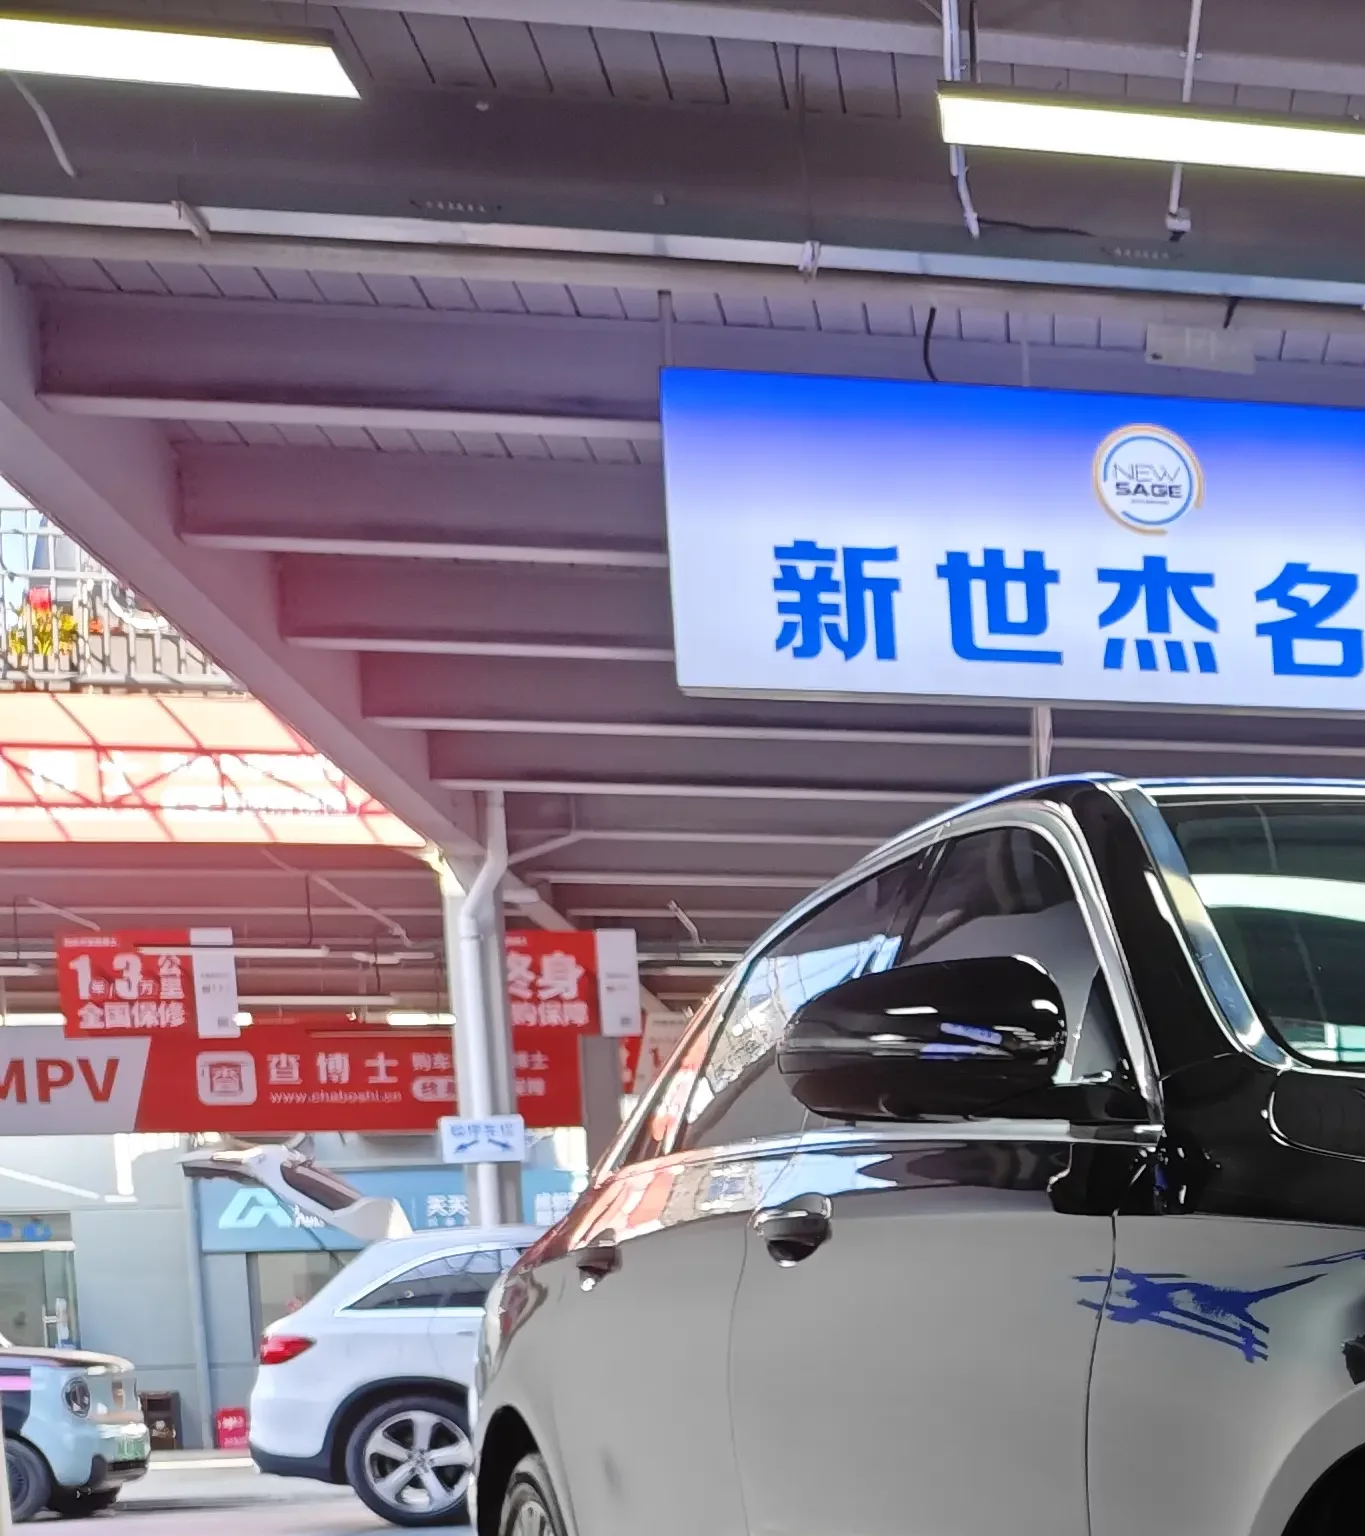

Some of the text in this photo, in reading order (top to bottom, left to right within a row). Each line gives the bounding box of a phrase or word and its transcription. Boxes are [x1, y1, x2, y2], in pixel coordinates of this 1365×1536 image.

[1112, 462, 1181, 482] NEW
[1115, 482, 1183, 499] SAGE
[77, 1001, 185, 1029] 全国保修
